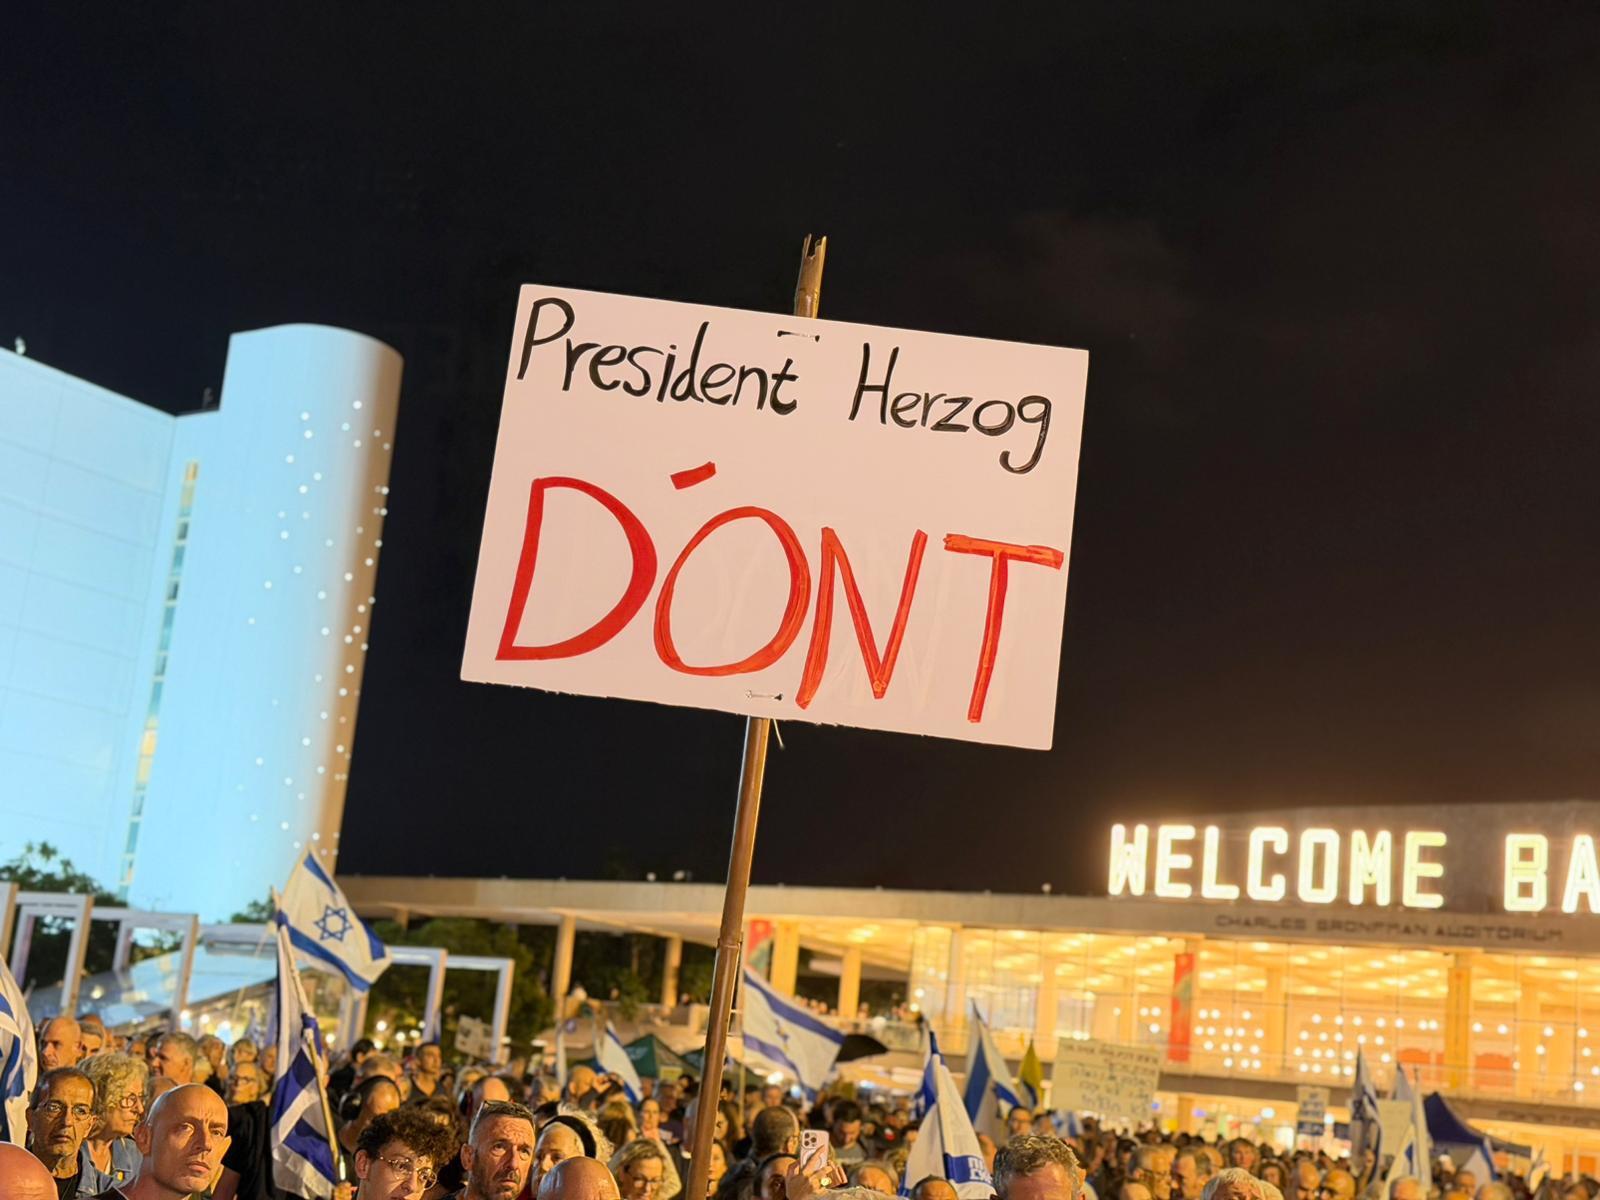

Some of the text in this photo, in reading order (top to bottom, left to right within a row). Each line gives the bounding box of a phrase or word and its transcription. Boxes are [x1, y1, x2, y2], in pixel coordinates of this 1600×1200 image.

[517, 297, 1052, 475] President Herzog
[1107, 822, 1600, 914] WELCOME BA
[1215, 914, 1564, 942] CHARLES BRONFMAN AUDITORIUM
